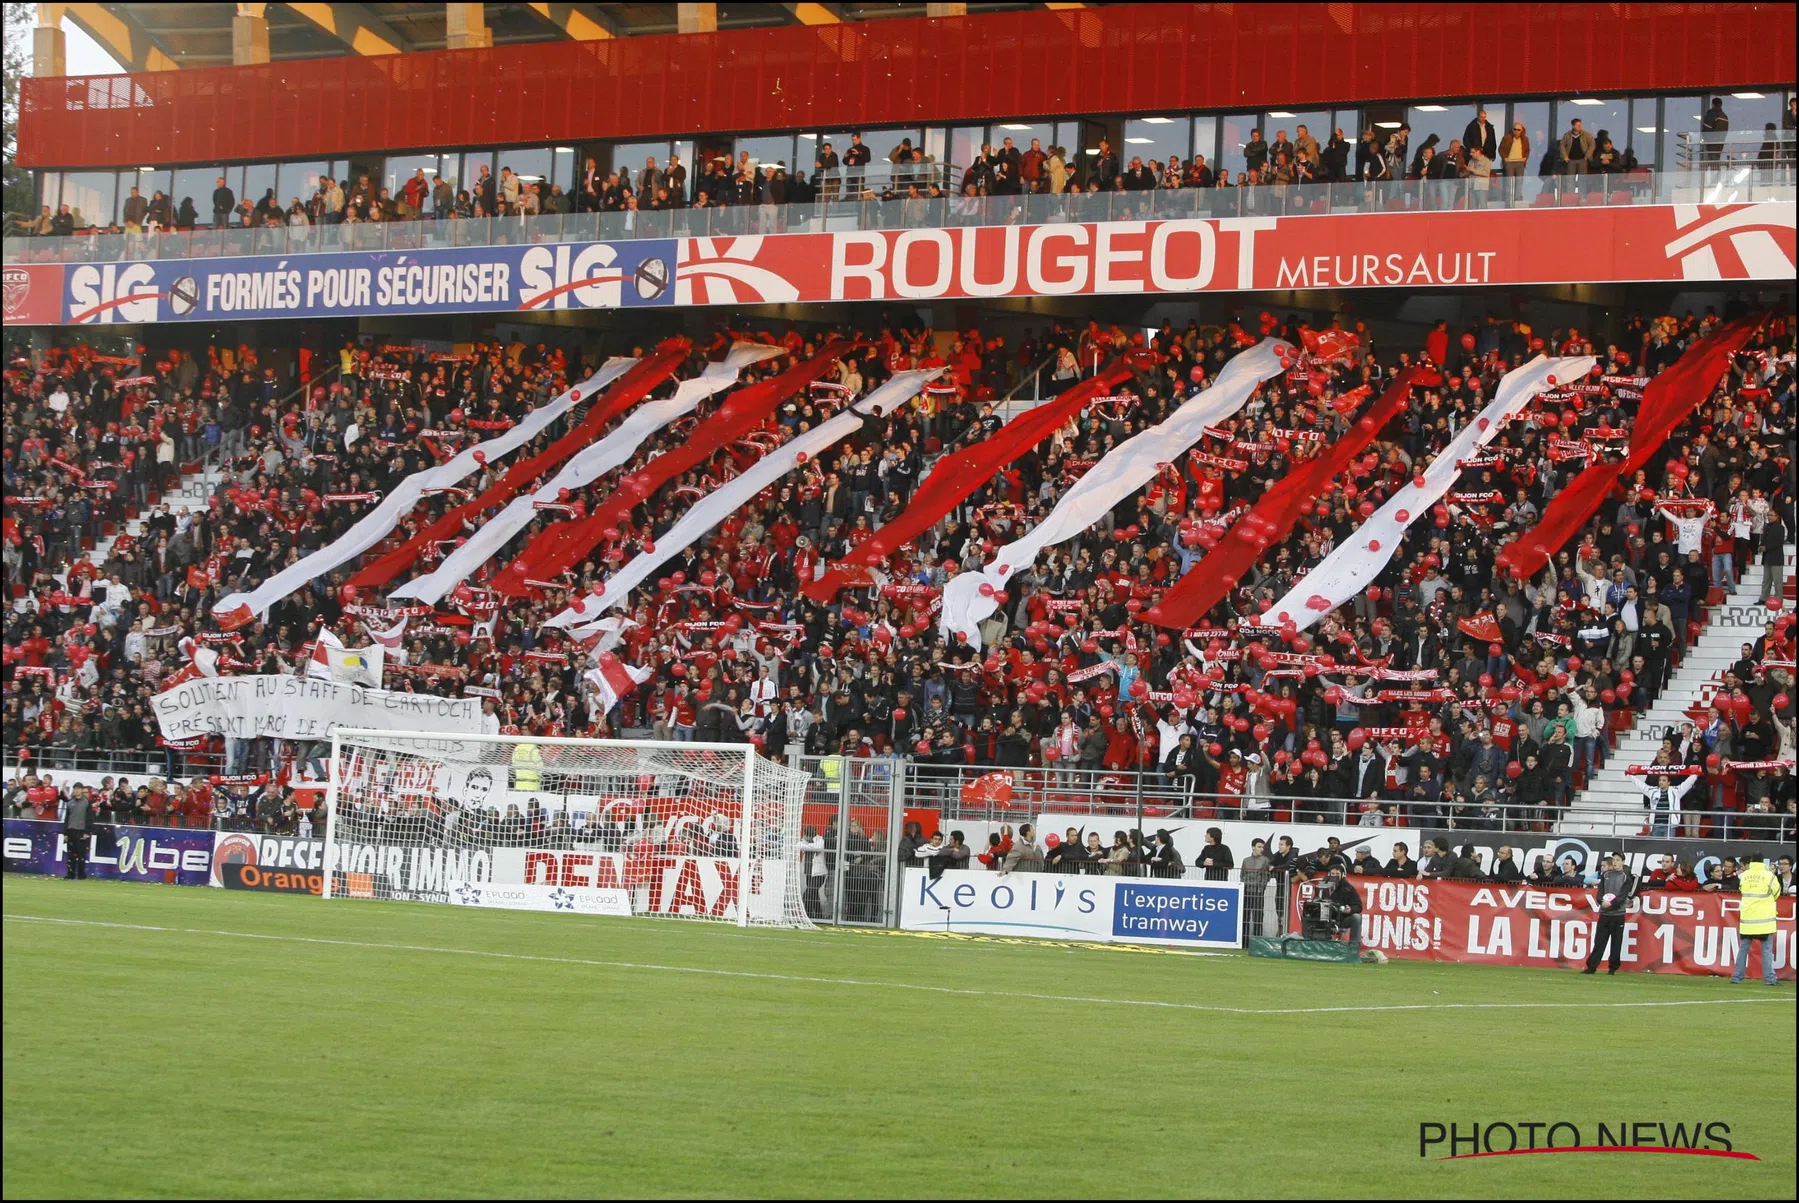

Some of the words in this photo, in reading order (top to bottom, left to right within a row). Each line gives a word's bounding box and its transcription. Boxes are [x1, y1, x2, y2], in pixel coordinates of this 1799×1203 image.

[830, 216, 1277, 300] ROUGEOT
[1276, 251, 1497, 288] MEURSAULT
[206, 260, 300, 312] FORMÉS
[307, 267, 372, 308] POUR
[378, 256, 510, 306] SÉCURISER
[520, 244, 622, 310] SIG
[70, 263, 159, 323] SIG
[1273, 430, 1319, 440] DFCO
[1484, 454, 1499, 462] FCO
[160, 681, 237, 715] SOUTIEN
[256, 677, 277, 698] AU
[284, 679, 338, 700] STAFF
[351, 688, 373, 705] DE
[384, 695, 472, 719] CARTOCH
[1149, 691, 1173, 700] DFCO
[295, 718, 317, 736] DE
[1371, 727, 1408, 735] DFCO
[4, 837, 32, 859] e
[239, 866, 337, 897] Orange
[919, 875, 1096, 914] Keolis
[1123, 889, 1229, 914] l'expertise
[1363, 882, 1430, 914] TOUS
[1470, 888, 1573, 911] AVEC
[1121, 913, 1210, 937] tramway
[1360, 913, 1443, 951] UNIS!
[1467, 914, 1513, 956] LA
[1653, 923, 1675, 964] 1
